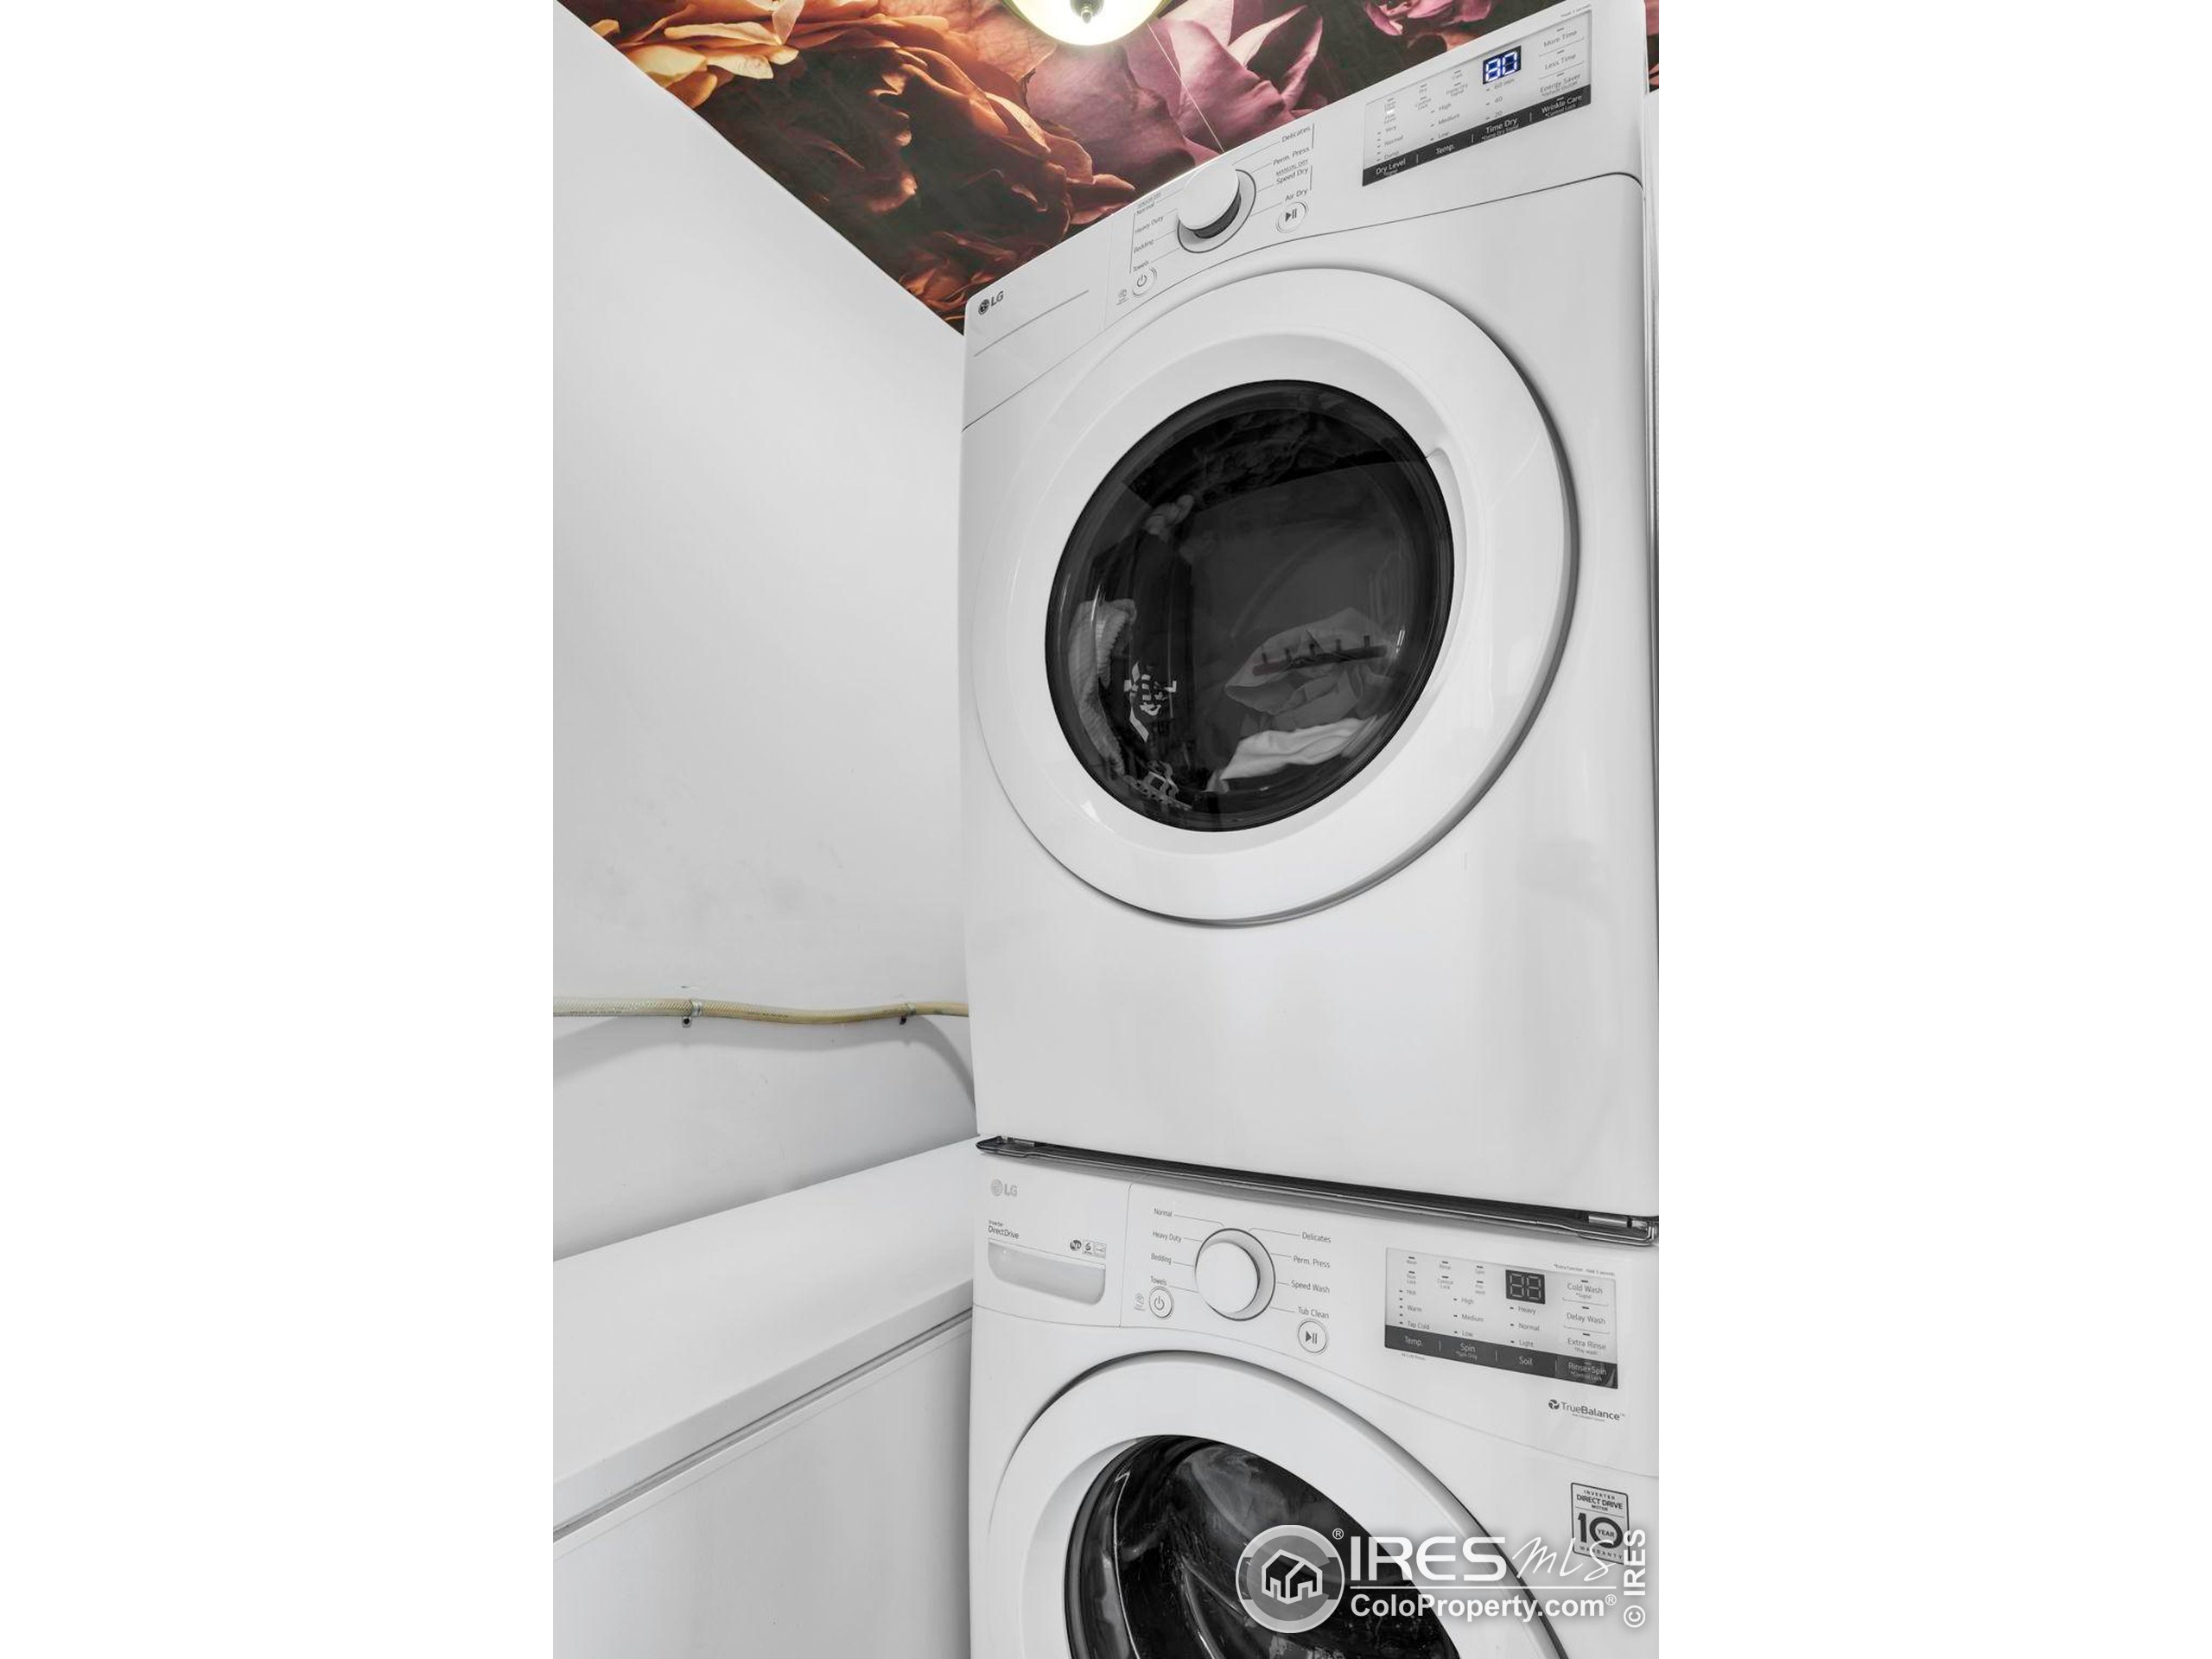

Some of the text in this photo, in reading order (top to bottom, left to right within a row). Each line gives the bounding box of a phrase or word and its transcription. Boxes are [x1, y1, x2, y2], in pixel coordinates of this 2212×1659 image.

[1543, 29, 1578, 48] More Time
[1485, 51, 1517, 82] 80
[1545, 54, 1577, 70] Less Time
[1541, 95, 1583, 114] Wrinkle Care
[1438, 113, 1460, 124] Medium
[1486, 118, 1518, 134] Time Dry
[1281, 126, 1311, 143] Delicates
[1384, 134, 1404, 146] Normal
[1292, 147, 1310, 157] Press
[1376, 165, 1389, 175] Dry
[1388, 157, 1407, 170] Level
[1276, 167, 1309, 184] Speed Dry
[1296, 189, 1307, 198] Dry
[1135, 223, 1150, 234] Heavy
[1134, 238, 1154, 254] Bedding
[1154, 1207, 1173, 1217] Normal
[1152, 1230, 1183, 1244] Heavy Duty
[1301, 1231, 1332, 1243] Delicates
[1150, 1253, 1172, 1266] Bedding
[1313, 1258, 1331, 1269] Press
[1150, 1275, 1167, 1286] Towels
[1291, 1280, 1331, 1294] Speed Wash
[1567, 1282, 1603, 1294] Cold Wash
[1298, 1306, 1329, 1319] Tub Clean
[1517, 1306, 1536, 1315] Heavy
[1461, 1313, 1484, 1322] Medium
[1567, 1312, 1605, 1325] Delay Wash
[1408, 1320, 1416, 1329] Tap
[1518, 1322, 1540, 1332] Normal
[1460, 1342, 1476, 1353] Spin
[1519, 1339, 1534, 1348] Light
[1567, 1338, 1607, 1350] Extra Rinse
[1519, 1356, 1534, 1366] Soil
[1568, 1362, 1607, 1376] Rinse+Spin
[1583, 1489, 1615, 1500] INVERTER
[1576, 1494, 1624, 1510] DIRECT DRIVE
[1591, 1503, 1609, 1512] MOTOR
[1578, 1512, 1624, 1549] 10
[1598, 1528, 1615, 1538] YEAR
